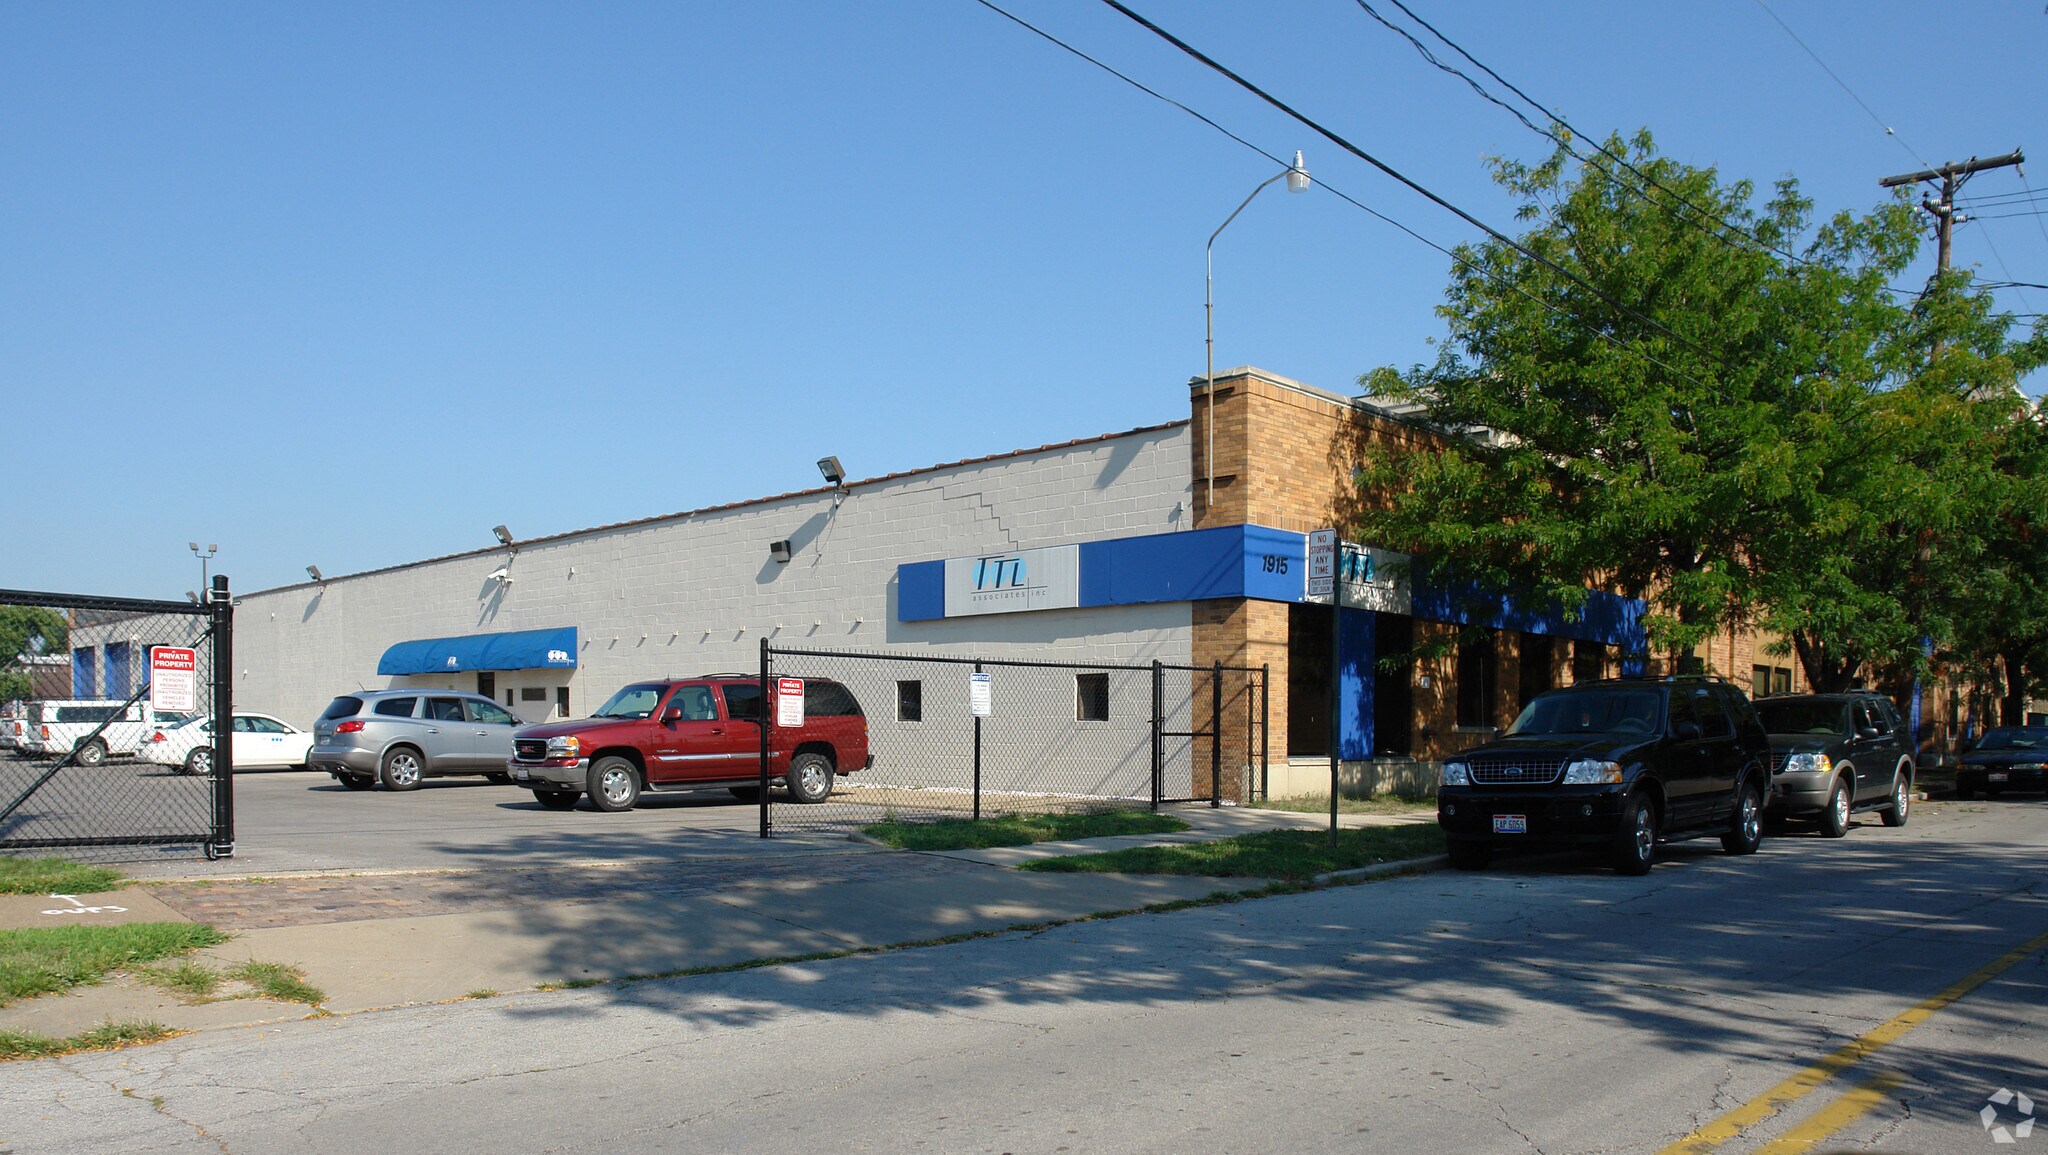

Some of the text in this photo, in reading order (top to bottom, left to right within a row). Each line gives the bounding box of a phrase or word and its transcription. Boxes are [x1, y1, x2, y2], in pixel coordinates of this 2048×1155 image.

[1318, 535, 1326, 543] NO
[1311, 545, 1333, 554] STOPPING
[1262, 555, 1288, 575] 1915
[1315, 556, 1328, 565] ANY
[977, 555, 1025, 590] TTL
[1315, 566, 1328, 575] TIME
[972, 591, 1025, 602] associates
[158, 652, 189, 660] PRIVATE
[1508, 820, 1525, 829] 6059
